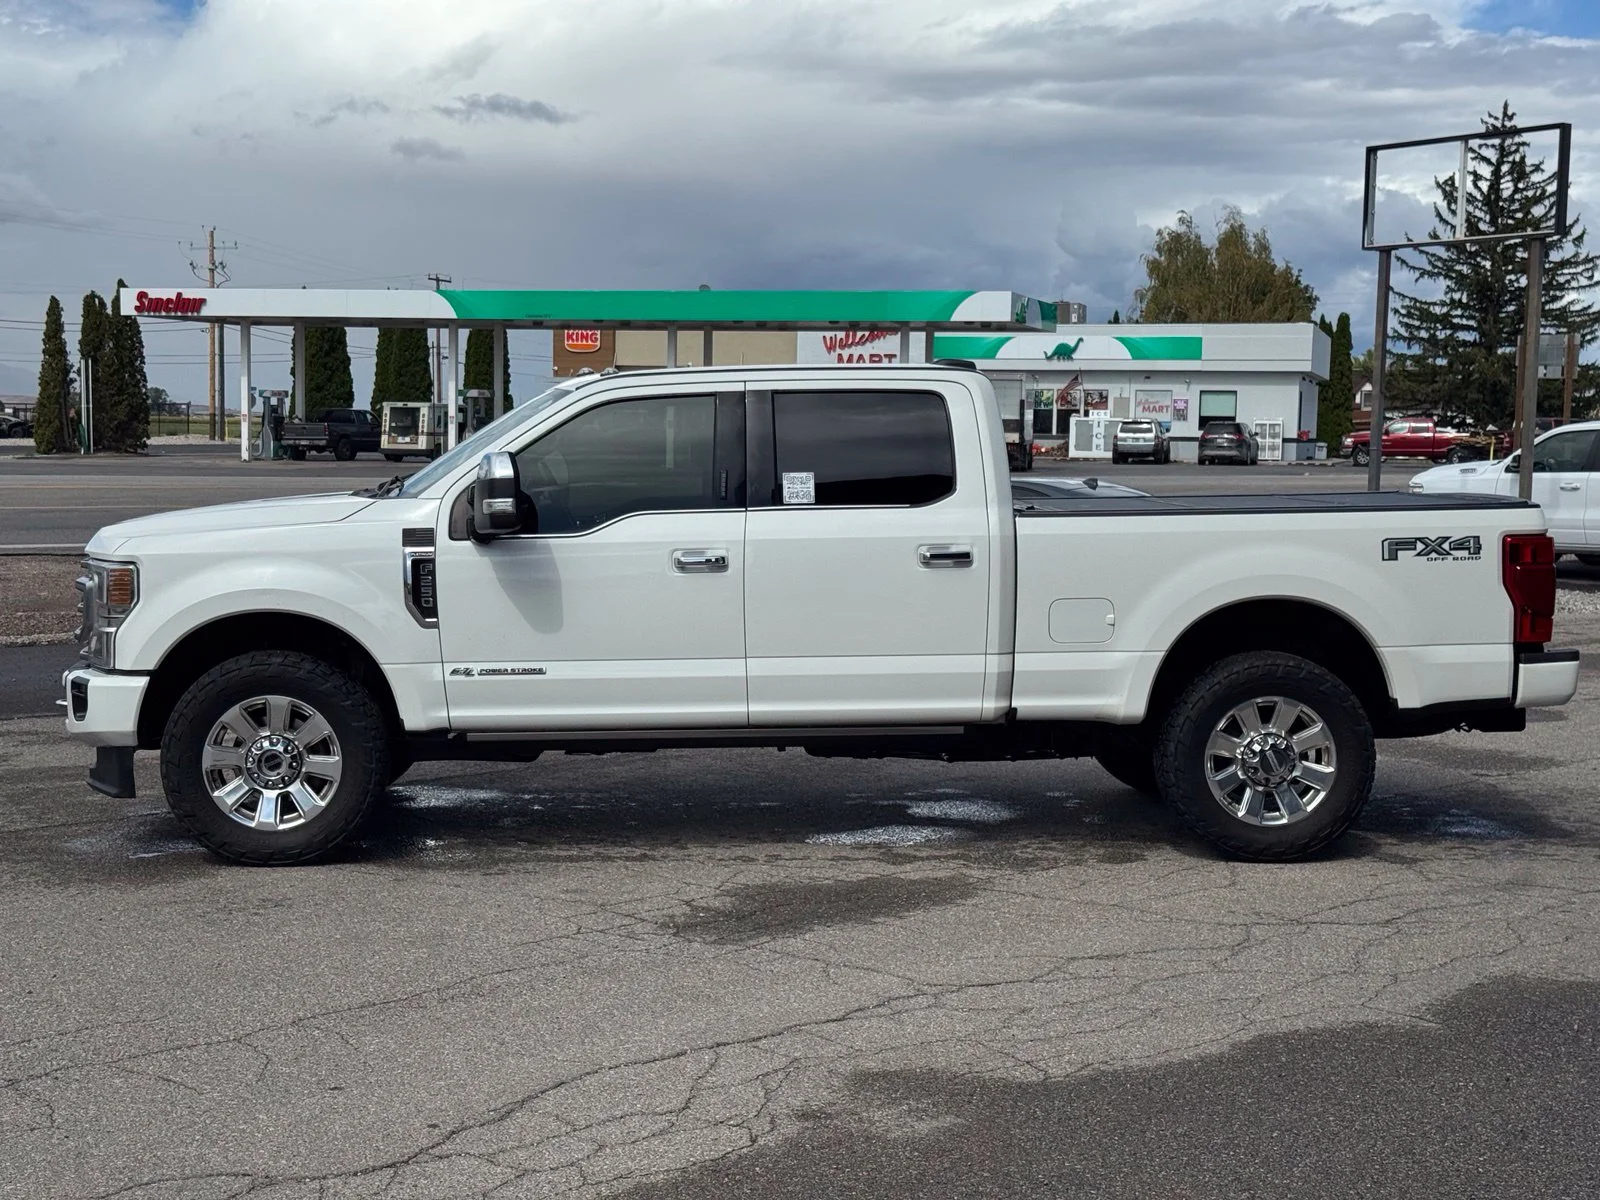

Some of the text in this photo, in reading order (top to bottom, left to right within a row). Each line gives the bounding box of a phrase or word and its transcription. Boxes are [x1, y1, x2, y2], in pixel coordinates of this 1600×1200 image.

[134, 291, 207, 313] Sinclair
[566, 331, 599, 344] KING
[837, 353, 897, 364] MART
[1142, 405, 1170, 413] MART
[1382, 536, 1482, 561] FX4
